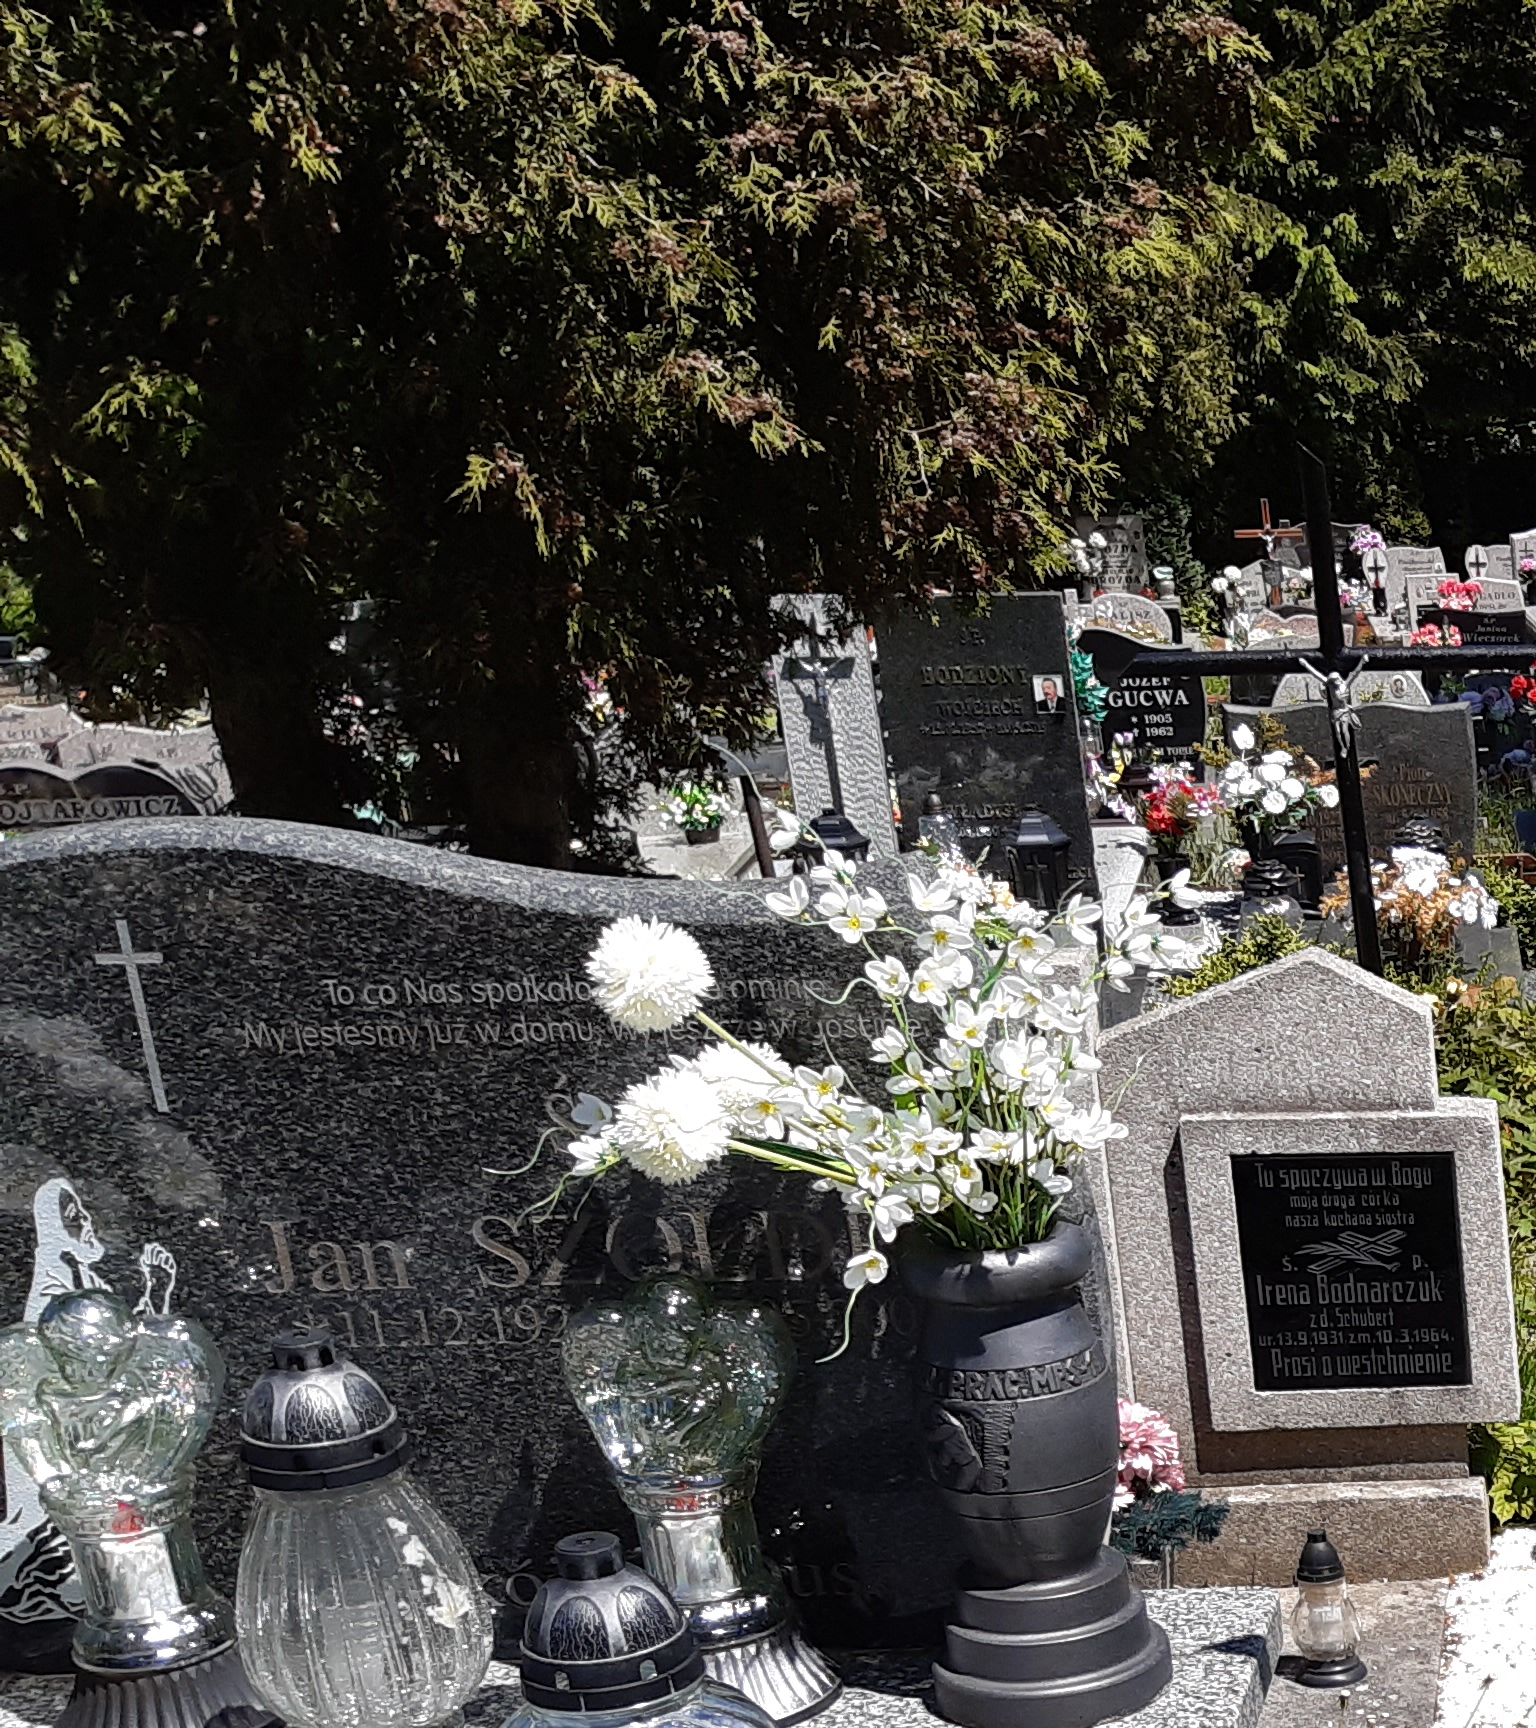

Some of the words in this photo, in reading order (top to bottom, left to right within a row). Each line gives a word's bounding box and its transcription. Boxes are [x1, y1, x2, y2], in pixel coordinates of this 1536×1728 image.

[1108, 689, 1190, 709] GUCWA
[363, 982, 396, 1006] co
[403, 974, 462, 1005] Nas
[244, 1020, 286, 1051] My
[475, 1022, 501, 1043] w
[1254, 1162, 1275, 1188] Tu
[1279, 1165, 1369, 1191] spoczywa
[1371, 1168, 1388, 1187] w
[1390, 1161, 1433, 1189] Bogu
[1289, 1192, 1319, 1210] moja
[1285, 1212, 1320, 1228] nasza
[261, 1220, 418, 1295] Jan
[1256, 1274, 1311, 1306] Irena
[1316, 1270, 1444, 1305] Bodnarczuk
[1336, 1306, 1395, 1328] Schubert
[1271, 1347, 1318, 1378] Prosi
[1322, 1354, 1333, 1376] o
[1336, 1344, 1453, 1377] westchnienie
